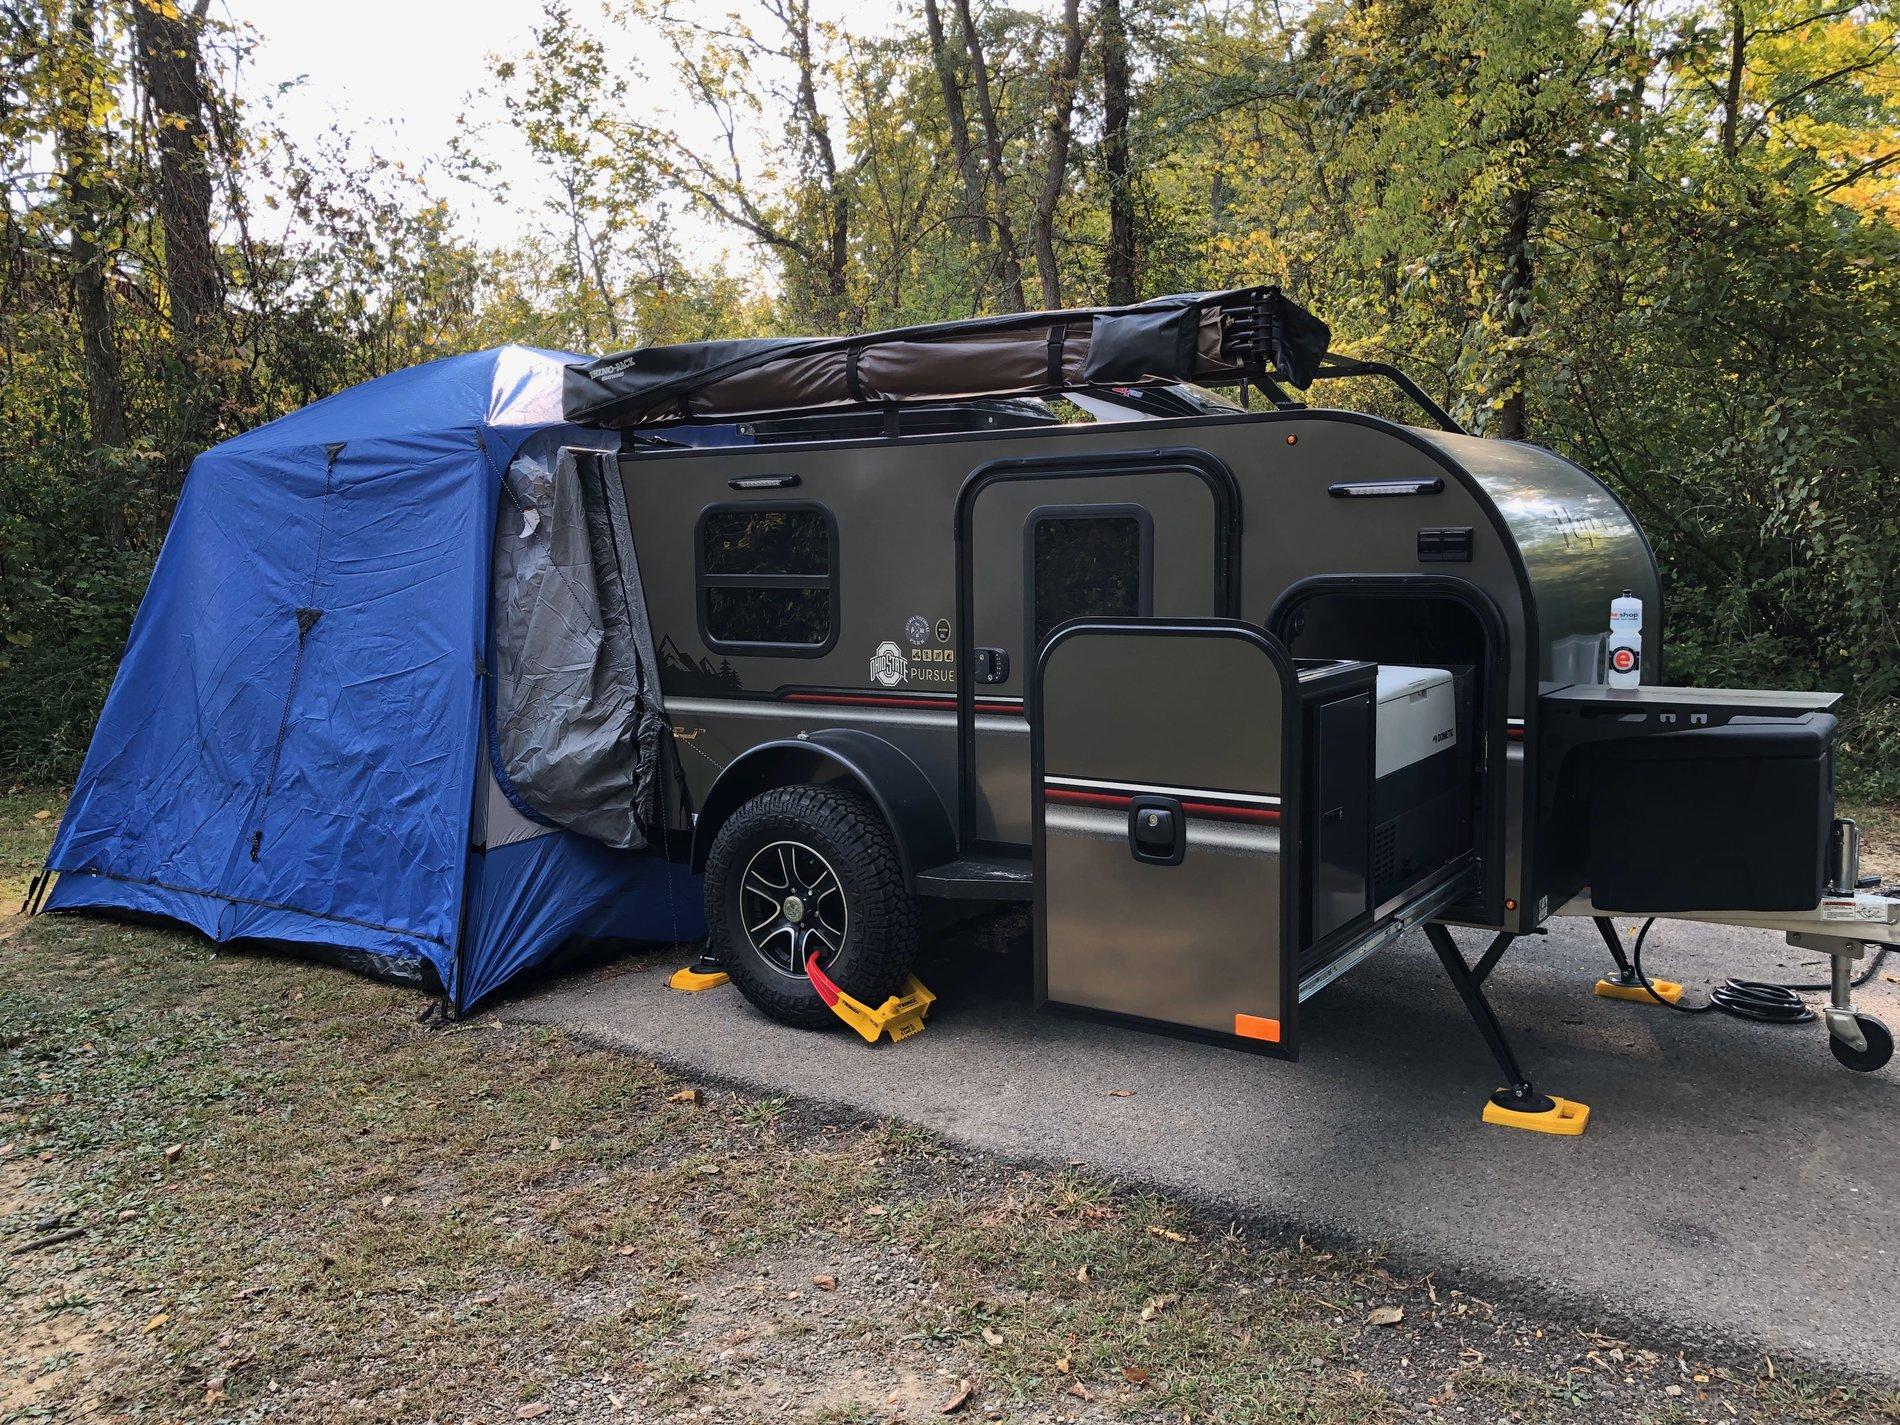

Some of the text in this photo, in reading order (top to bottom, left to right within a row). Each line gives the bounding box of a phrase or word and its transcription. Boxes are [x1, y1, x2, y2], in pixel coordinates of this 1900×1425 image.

[870, 653, 909, 683] OHIO STATE
[910, 667, 955, 682] PURSUE
